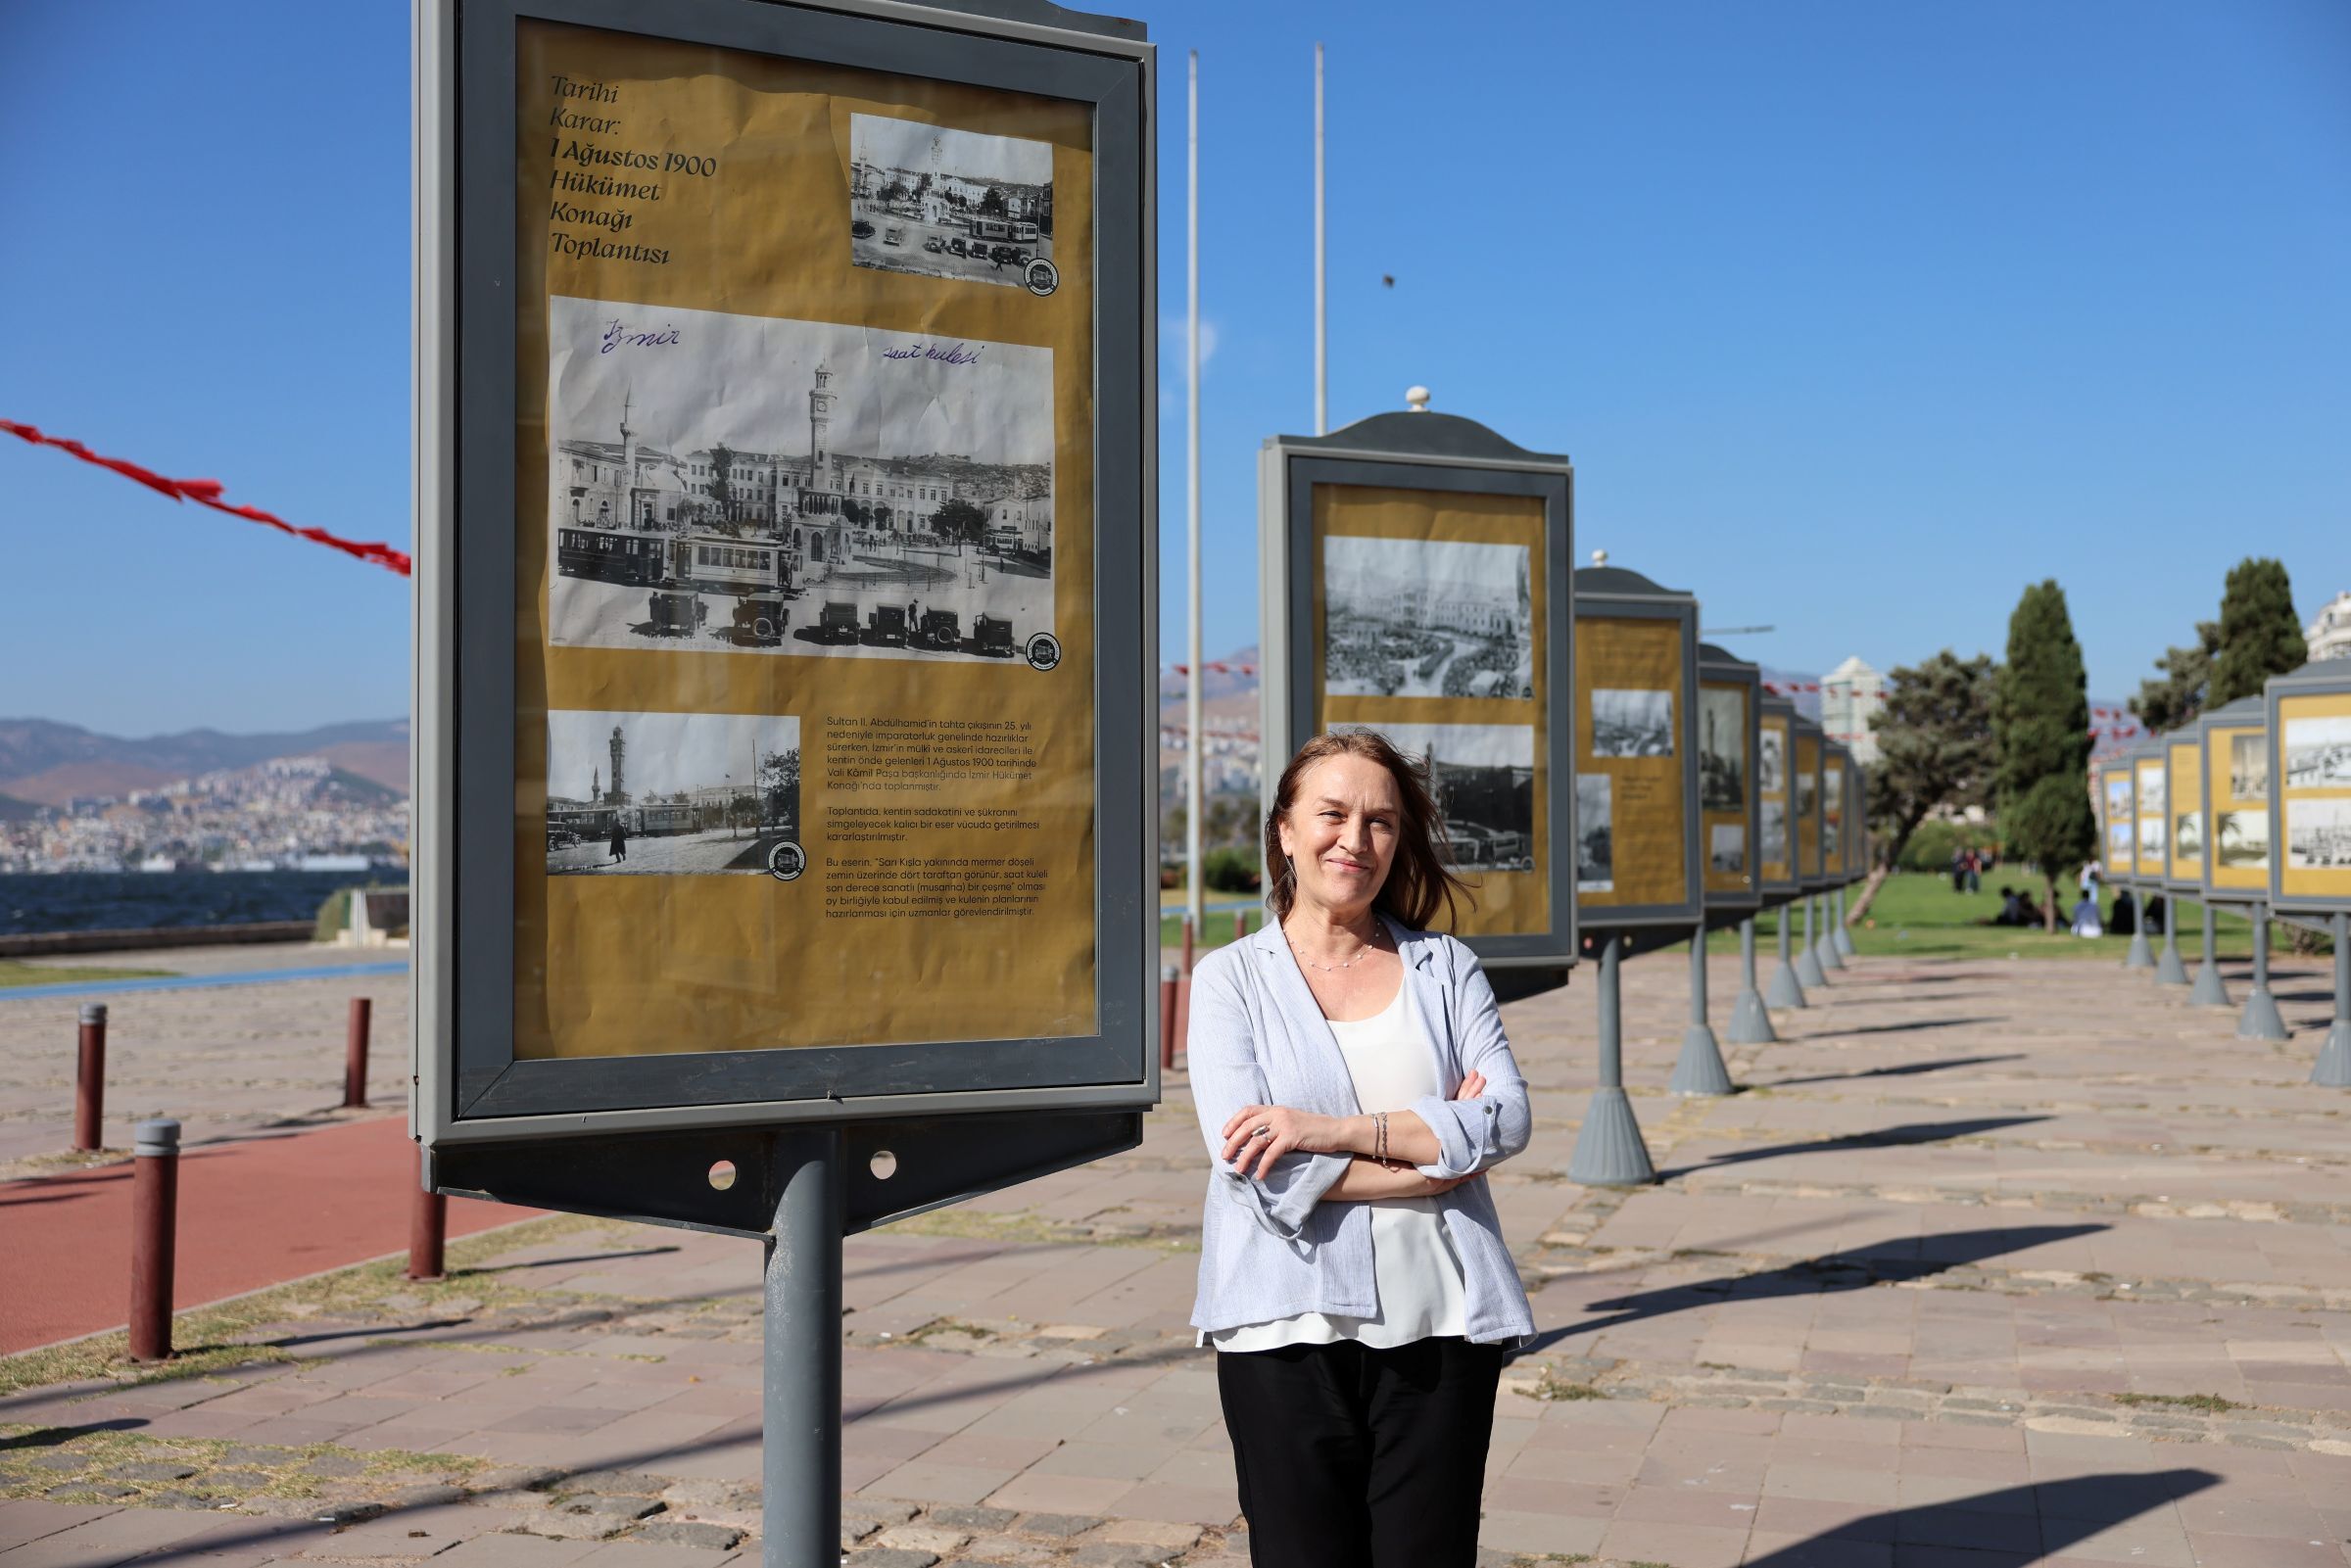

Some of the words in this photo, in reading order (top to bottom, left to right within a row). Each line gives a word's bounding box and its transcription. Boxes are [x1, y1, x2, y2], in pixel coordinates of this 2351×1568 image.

[552, 75, 619, 104] Tarihi
[550, 107, 621, 135] Karar:
[562, 140, 658, 169] Ağustos
[664, 153, 717, 177] 1900
[550, 169, 663, 201] Hükümet
[550, 201, 633, 233] Konağı
[552, 232, 670, 264] Toplantısı
[827, 716, 858, 726] Sultan
[939, 720, 966, 729] tahta
[1004, 721, 1018, 731] 25.
[827, 730, 874, 740] nedeniyle
[876, 732, 937, 741] imparatorluk
[937, 733, 984, 742] genelinde
[985, 734, 1029, 742] hazırlıklar
[1022, 746, 1033, 755] ile
[827, 755, 856, 764] kentin
[858, 755, 883, 765] önde
[885, 756, 925, 767] gelenleri
[933, 757, 971, 768] Ağustos
[972, 758, 994, 767] 1900
[996, 758, 1037, 768] tarihinde
[827, 768, 844, 777] Vali
[876, 768, 899, 779] Paşa
[901, 770, 967, 781] başkanlığında
[992, 770, 1032, 780] Hükümet
[883, 807, 912, 816] kentin
[913, 807, 962, 817] sadakatini
[827, 820, 891, 830] simgeleyecek
[893, 820, 918, 829] kalıcı
[920, 820, 933, 829] bir
[993, 821, 1040, 831] getirilmesi
[826, 857, 839, 867] Bu
[923, 858, 969, 868] yakınında
[1008, 857, 1034, 868] döşeli
[826, 871, 854, 879] zemin
[856, 871, 898, 879] üzerinde
[845, 883, 880, 892] derece
[882, 883, 915, 892] sanatlı
[968, 882, 981, 891] bir
[826, 897, 838, 906] oy
[883, 896, 909, 905] kabul
[958, 895, 990, 904] kulenin
[826, 909, 887, 918] hazırlanması
[888, 909, 906, 919] için
